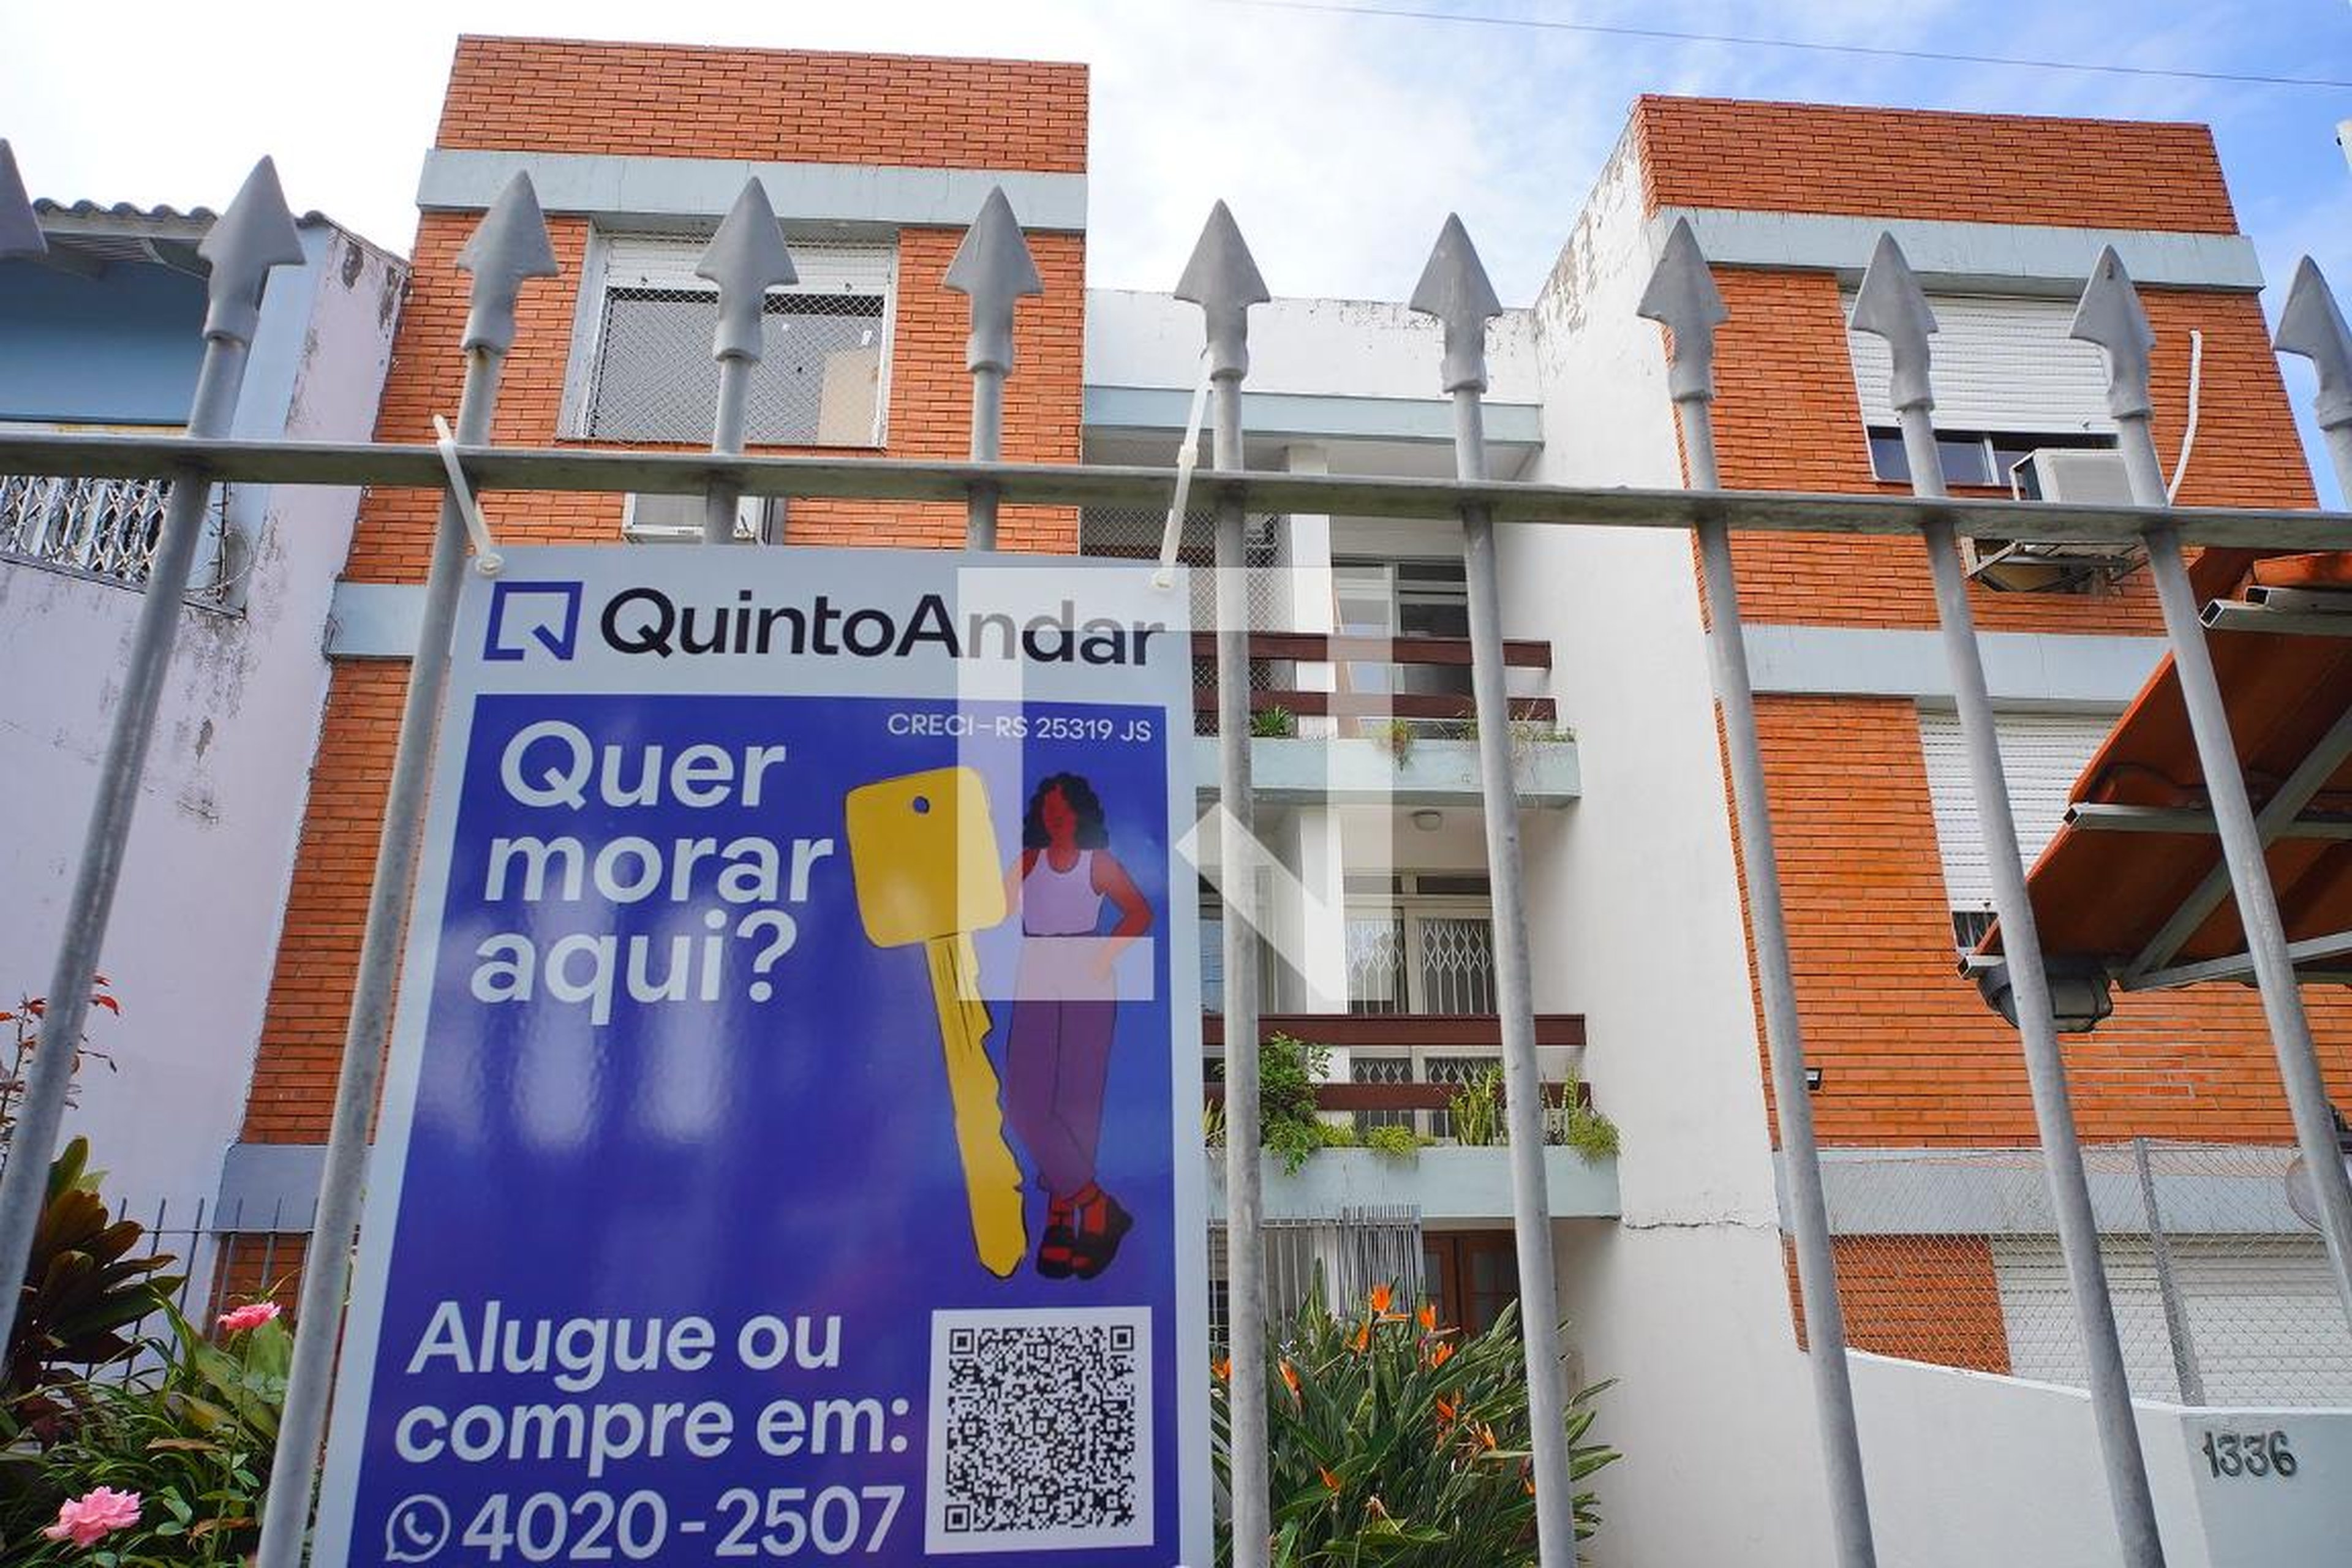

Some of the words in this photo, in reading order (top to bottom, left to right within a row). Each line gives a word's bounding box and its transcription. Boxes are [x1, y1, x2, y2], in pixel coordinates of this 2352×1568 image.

[600, 586, 1165, 666] QuintoAndar
[500, 720, 786, 811] Quer
[1036, 717, 1114, 740] 25319
[1120, 720, 1152, 741] JS
[485, 836, 834, 903] morar
[471, 908, 797, 1025] aqui?
[406, 1300, 715, 1392] Alugue
[738, 1314, 842, 1370] ou
[395, 1399, 734, 1478] compre
[756, 1398, 910, 1457] em:
[2201, 1431, 2298, 1479] 1336
